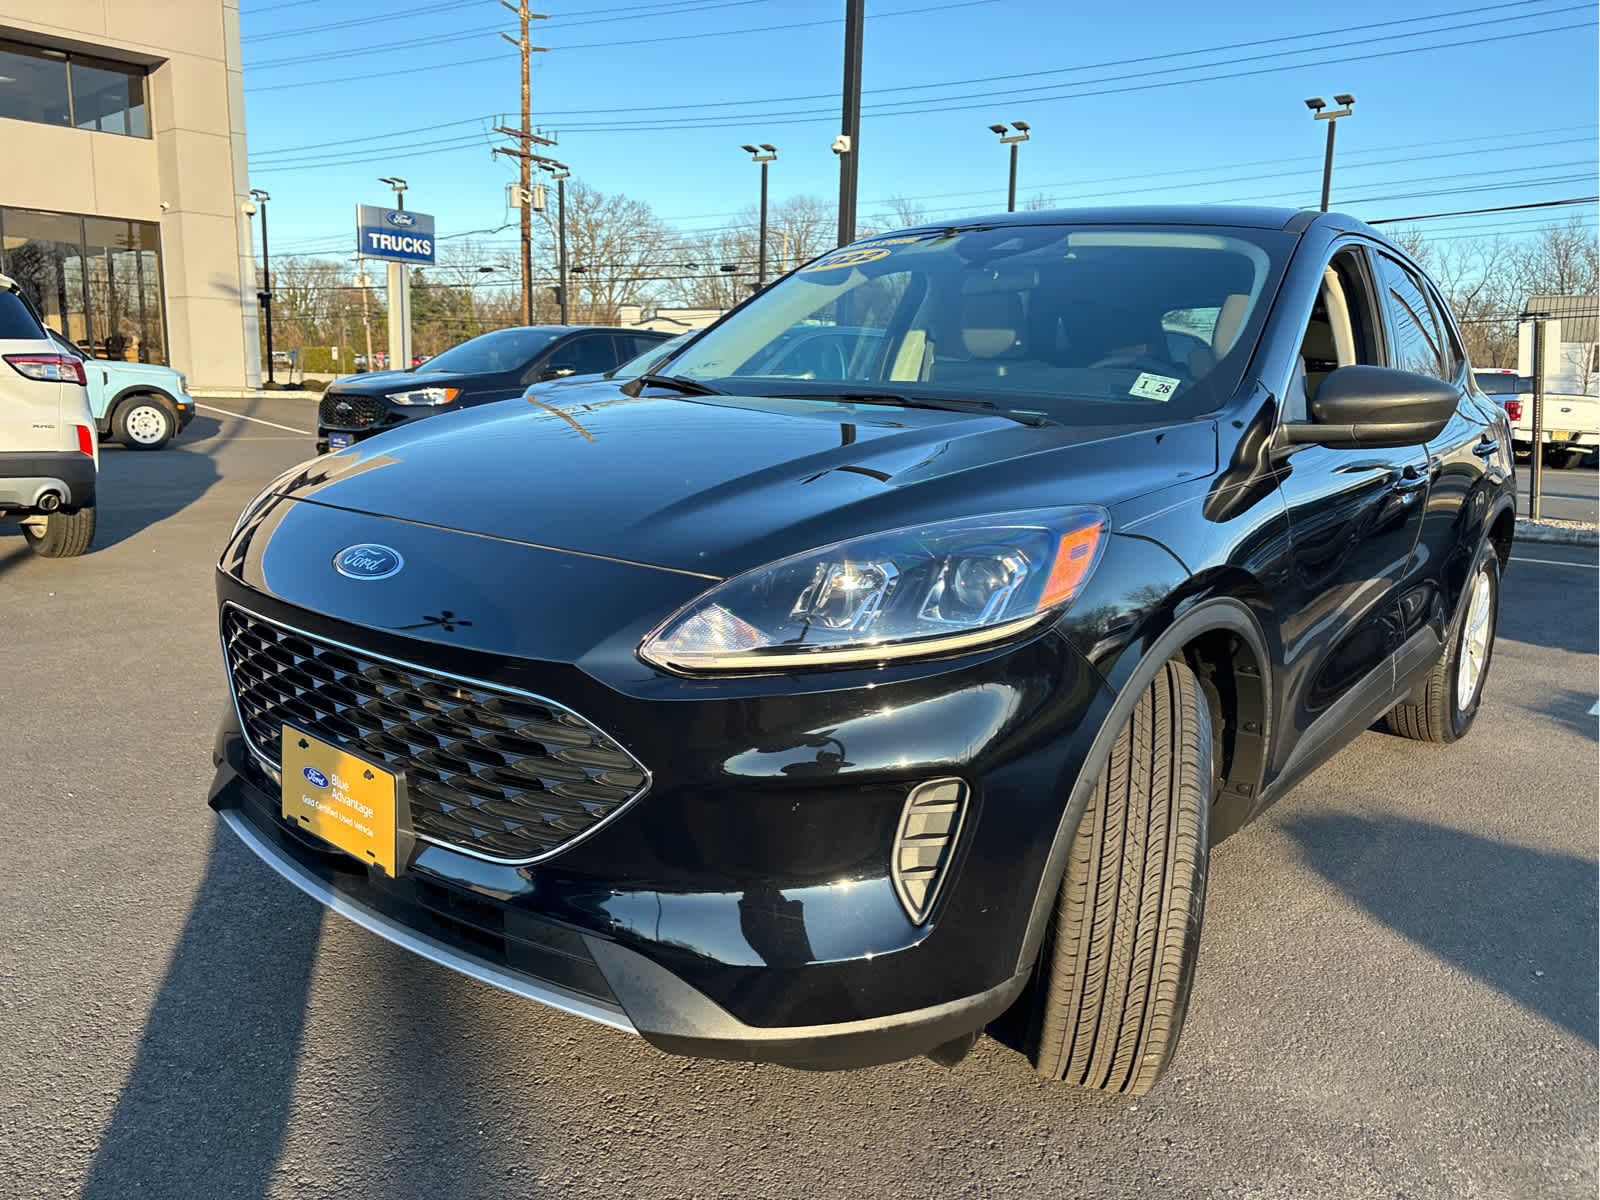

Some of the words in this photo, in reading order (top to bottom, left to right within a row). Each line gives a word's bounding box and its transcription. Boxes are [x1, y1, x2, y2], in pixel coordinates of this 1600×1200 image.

[368, 232, 432, 256] TRUCKS
[1140, 380, 1149, 389] 1
[1155, 383, 1172, 394] 28
[343, 548, 387, 571] Ford
[307, 768, 325, 786] Ford
[331, 773, 350, 792] Blue
[302, 794, 315, 807] Gold
[338, 811, 353, 826] Used
[331, 787, 374, 818] Advantage
